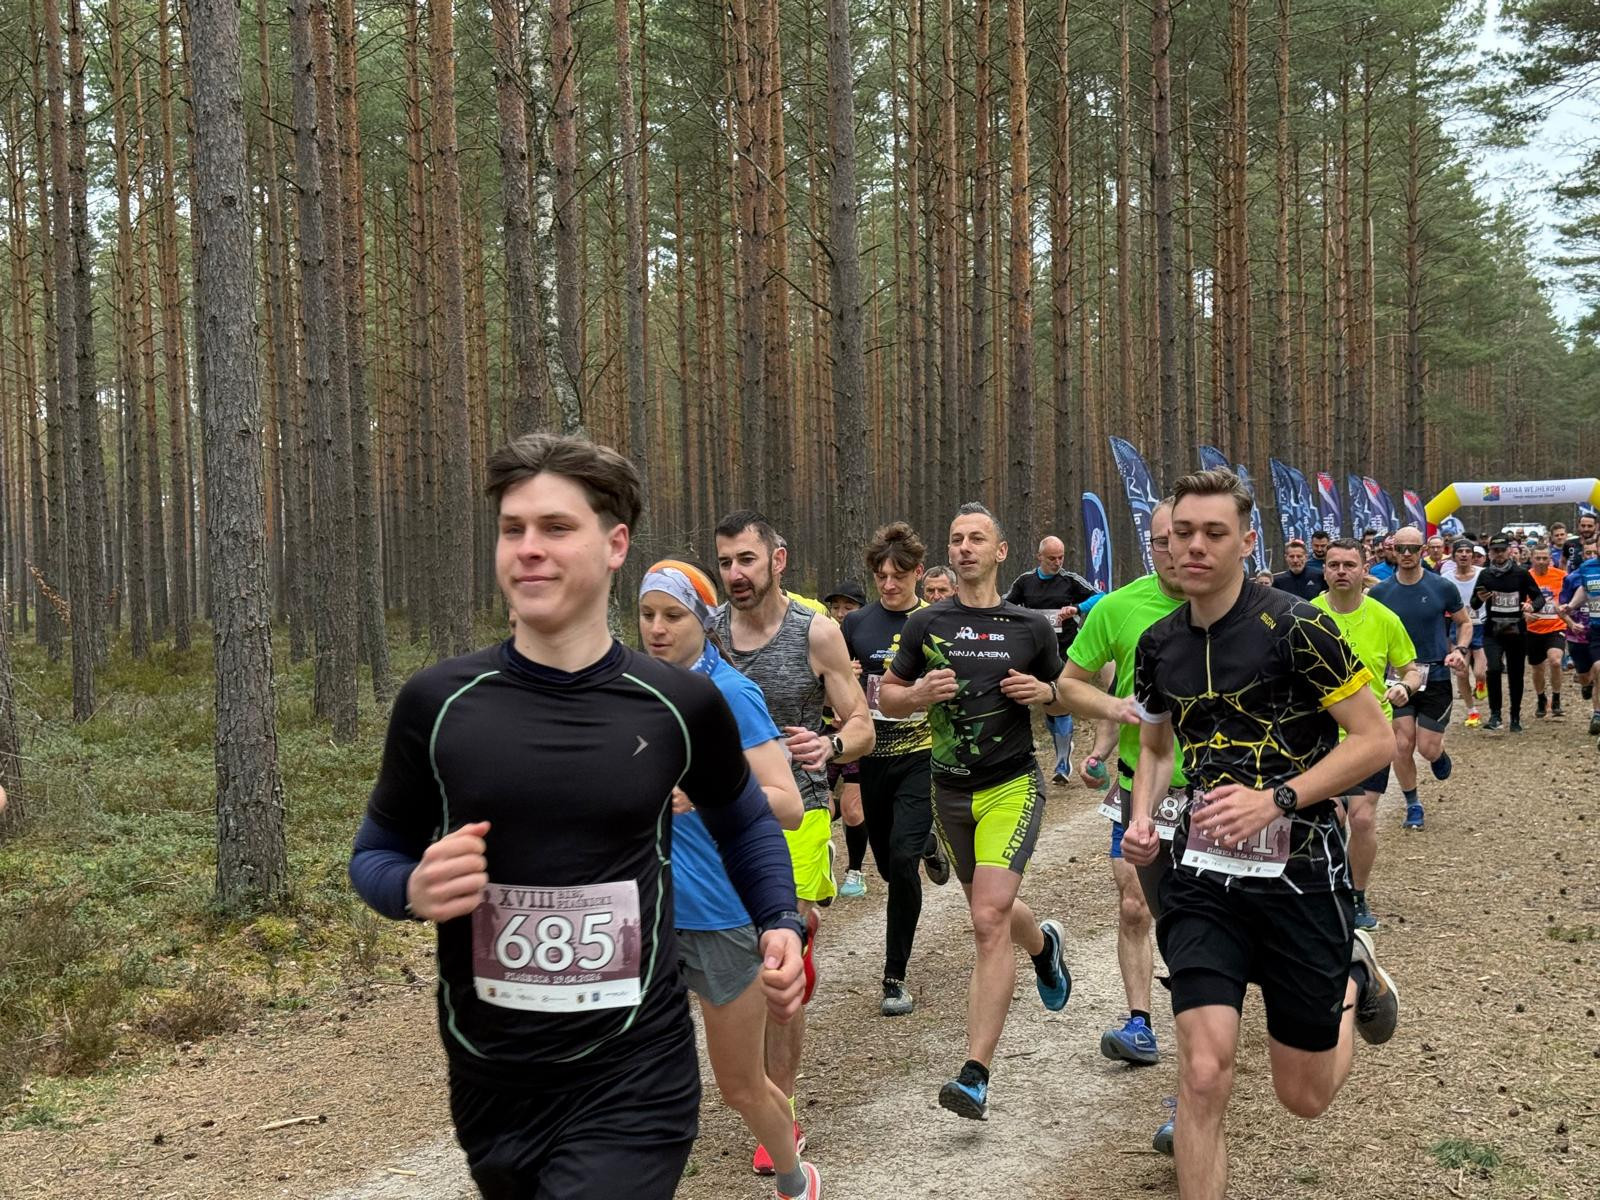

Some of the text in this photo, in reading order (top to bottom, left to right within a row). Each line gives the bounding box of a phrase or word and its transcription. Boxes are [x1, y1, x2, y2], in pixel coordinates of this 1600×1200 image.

[1502, 484, 1566, 494] GMINA WEJHEROWO
[977, 651, 1010, 659] ARENA
[499, 888, 555, 908] XVIII
[495, 912, 616, 972] 685
